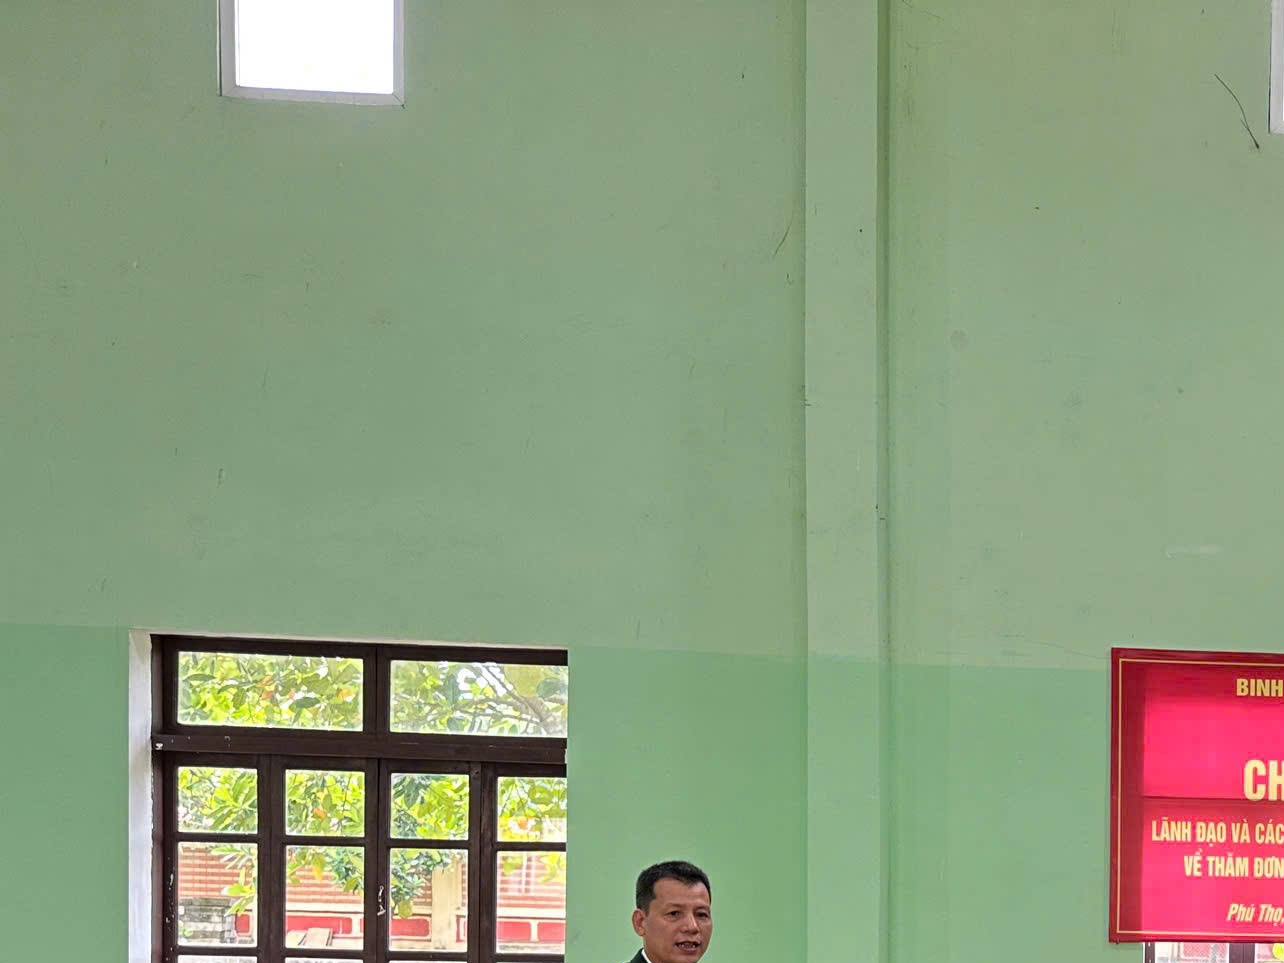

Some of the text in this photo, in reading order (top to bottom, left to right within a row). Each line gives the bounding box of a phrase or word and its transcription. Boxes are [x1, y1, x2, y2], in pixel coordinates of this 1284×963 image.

[1236, 678, 1283, 697] BINH
[1152, 817, 1191, 841] LÃNH
[1196, 822, 1226, 847] ĐẠO
[1232, 819, 1250, 843] VÀ
[1255, 819, 1284, 844] CÁC
[1184, 849, 1202, 876] VỀ
[1208, 852, 1249, 877] THĂM
[1254, 856, 1284, 878] ĐƠN
[1227, 904, 1255, 922] Phú
